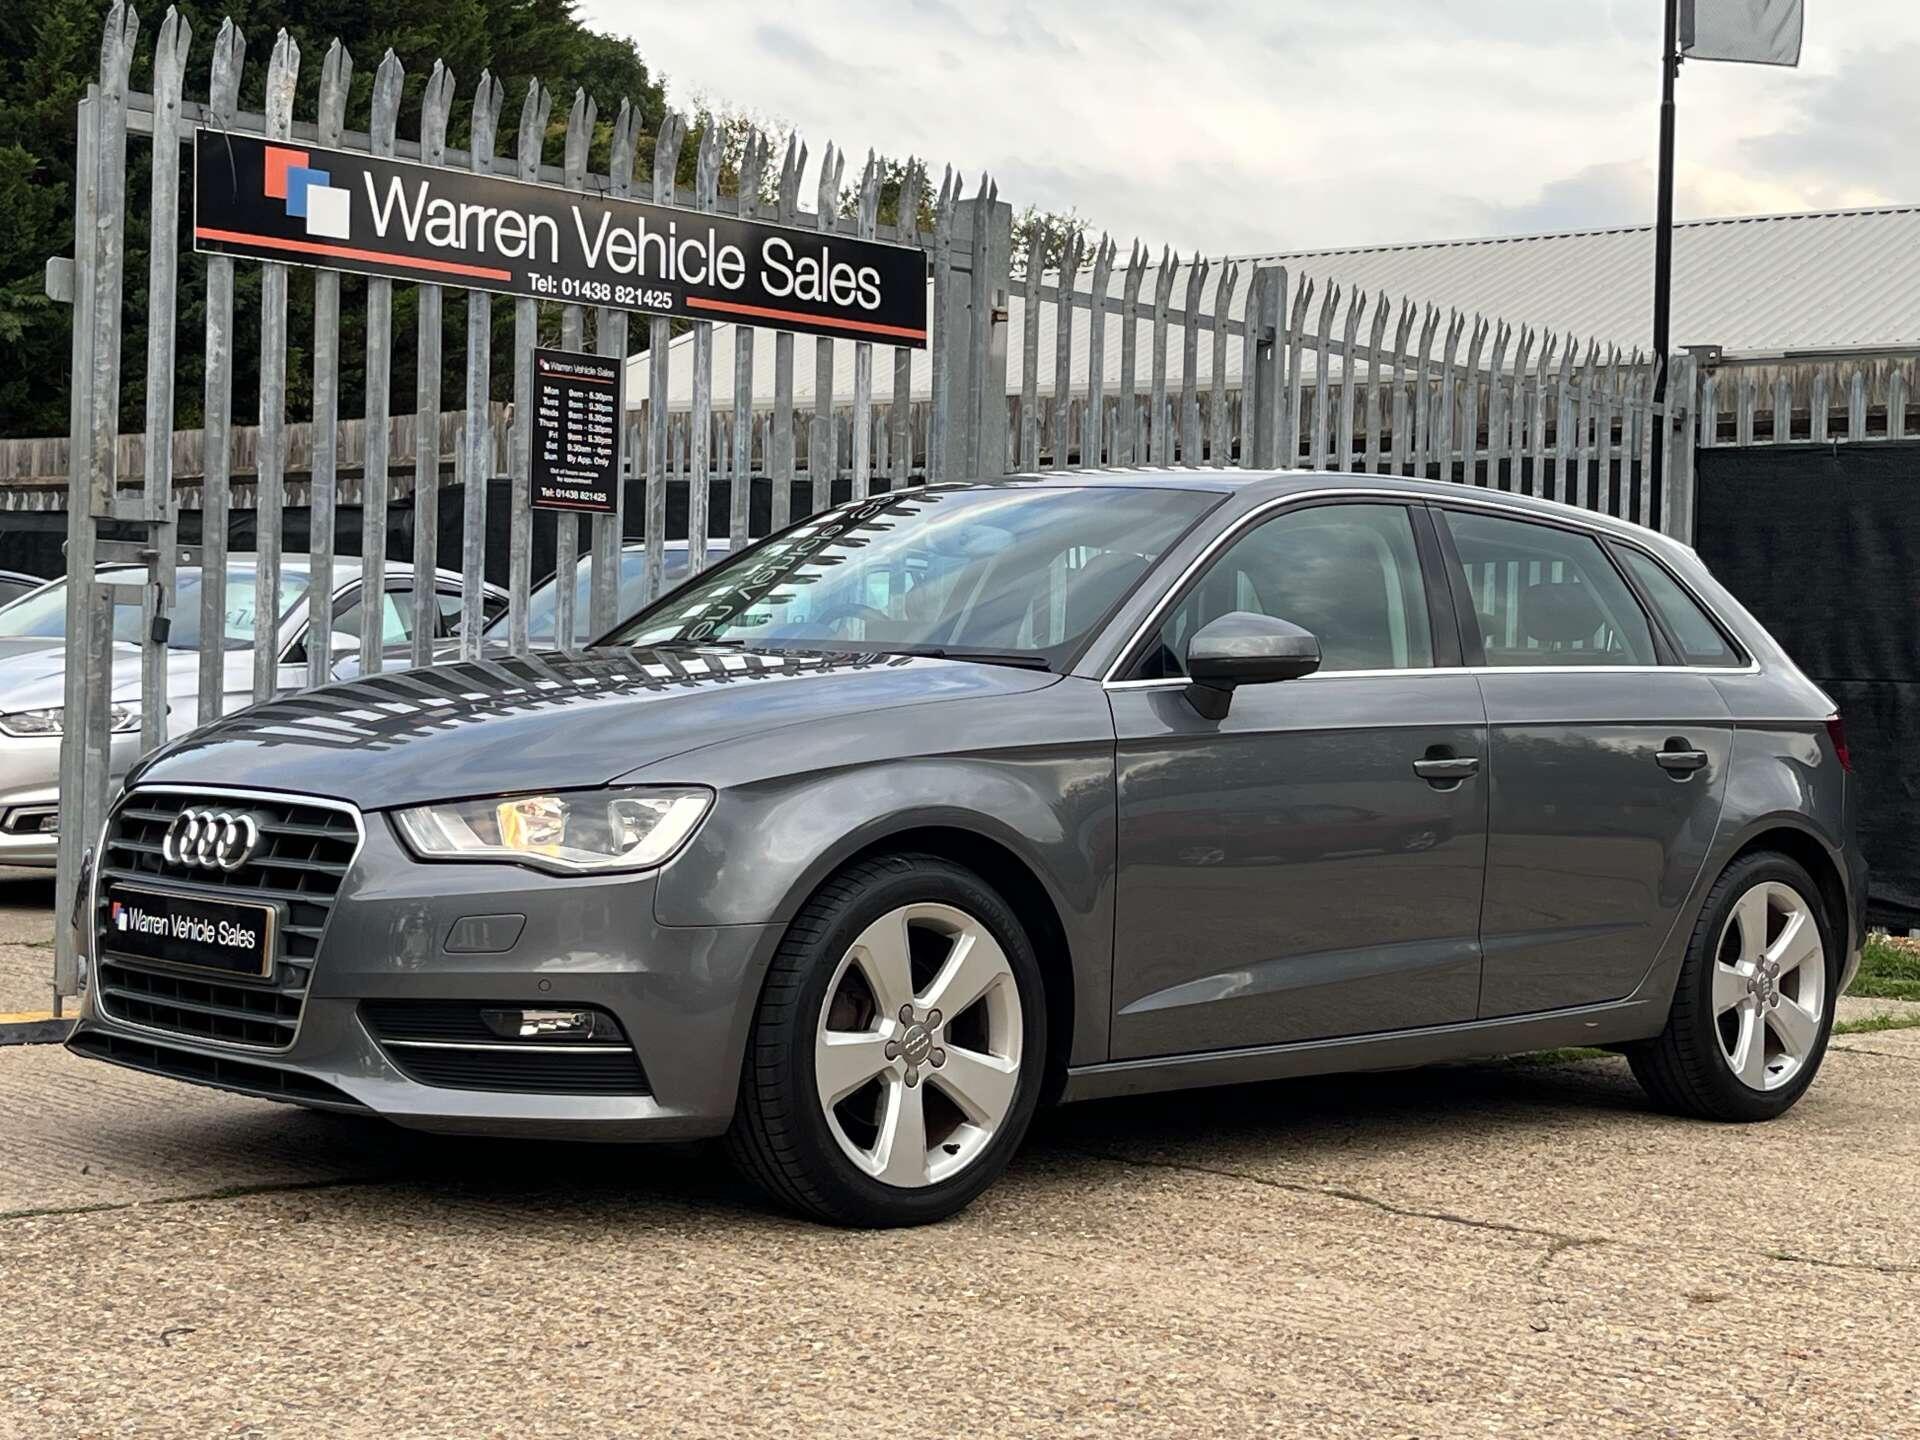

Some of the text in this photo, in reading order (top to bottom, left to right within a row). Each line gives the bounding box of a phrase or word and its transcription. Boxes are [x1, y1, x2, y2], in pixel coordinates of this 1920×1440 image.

[363, 170, 882, 310] Warren Vehicle Sales
[528, 272, 673, 309] Tel: 01438 821425
[550, 361, 615, 378] Warren Vehicle Sales
[543, 385, 560, 395] Mon
[548, 430, 559, 439] Fri
[545, 441, 558, 450] Sat
[543, 451, 558, 461] Sun
[566, 453, 577, 464] By
[593, 456, 610, 468] Only
[541, 486, 608, 502] Tel: 01438 821425
[128, 906, 256, 949] Warren Vehicle Sales
